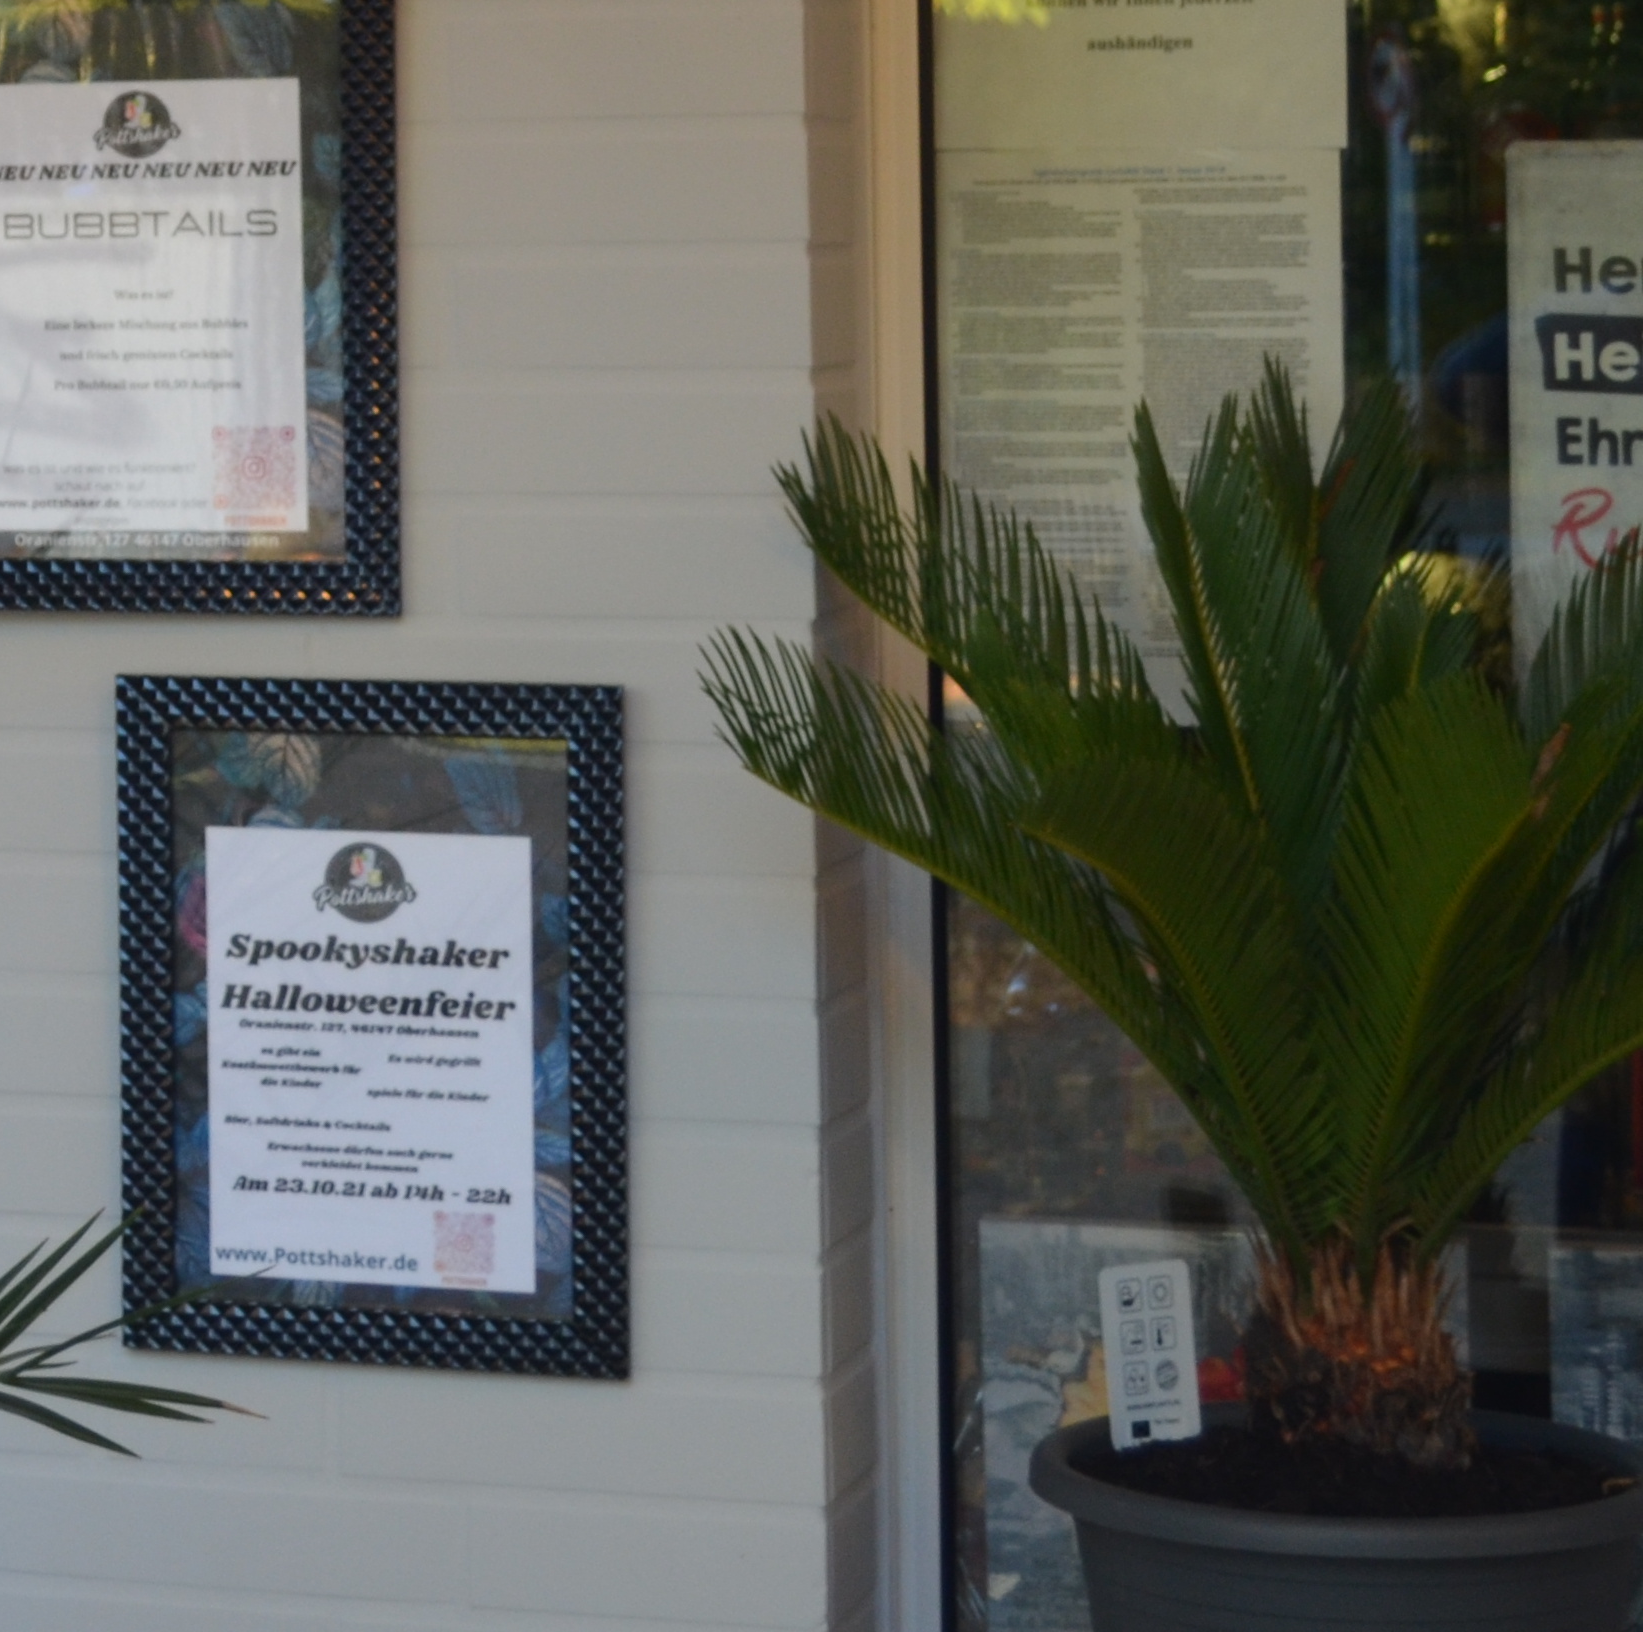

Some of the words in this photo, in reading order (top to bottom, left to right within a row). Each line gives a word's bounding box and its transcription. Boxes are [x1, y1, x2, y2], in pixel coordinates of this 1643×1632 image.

[1087, 33, 1194, 53] aushändigen
[93, 120, 182, 152] Pottshaker
[38, 164, 86, 181] NEU
[90, 163, 139, 180] NEU
[142, 162, 191, 179] NEU
[193, 161, 243, 178] NEU
[247, 160, 297, 176] NEU
[3, 210, 279, 240] BUBBTAILS
[1553, 247, 1643, 294] He
[44, 319, 71, 331] Eine
[1553, 332, 1643, 381] He
[134, 533, 180, 548] 46147
[182, 533, 282, 548] Oberhausen
[313, 882, 418, 912] Pottshaker
[225, 932, 512, 970] Spookyshaker
[220, 982, 517, 1022] Halloweenfeier
[239, 1019, 318, 1031] Oranienstr.
[351, 1024, 394, 1035] 46147
[396, 1025, 480, 1038] Oberhausen
[281, 1078, 323, 1089] Kinder
[448, 1091, 490, 1102] Kinder
[334, 1120, 392, 1133] Cocktails
[267, 1141, 341, 1154] Erwachsene
[233, 1174, 270, 1192] Am
[274, 1176, 367, 1197] 23.10.21
[370, 1180, 399, 1200] ab
[404, 1183, 445, 1203] 14h
[465, 1185, 512, 1206] 22h
[215, 1245, 419, 1272] www.Pottshaker.de
